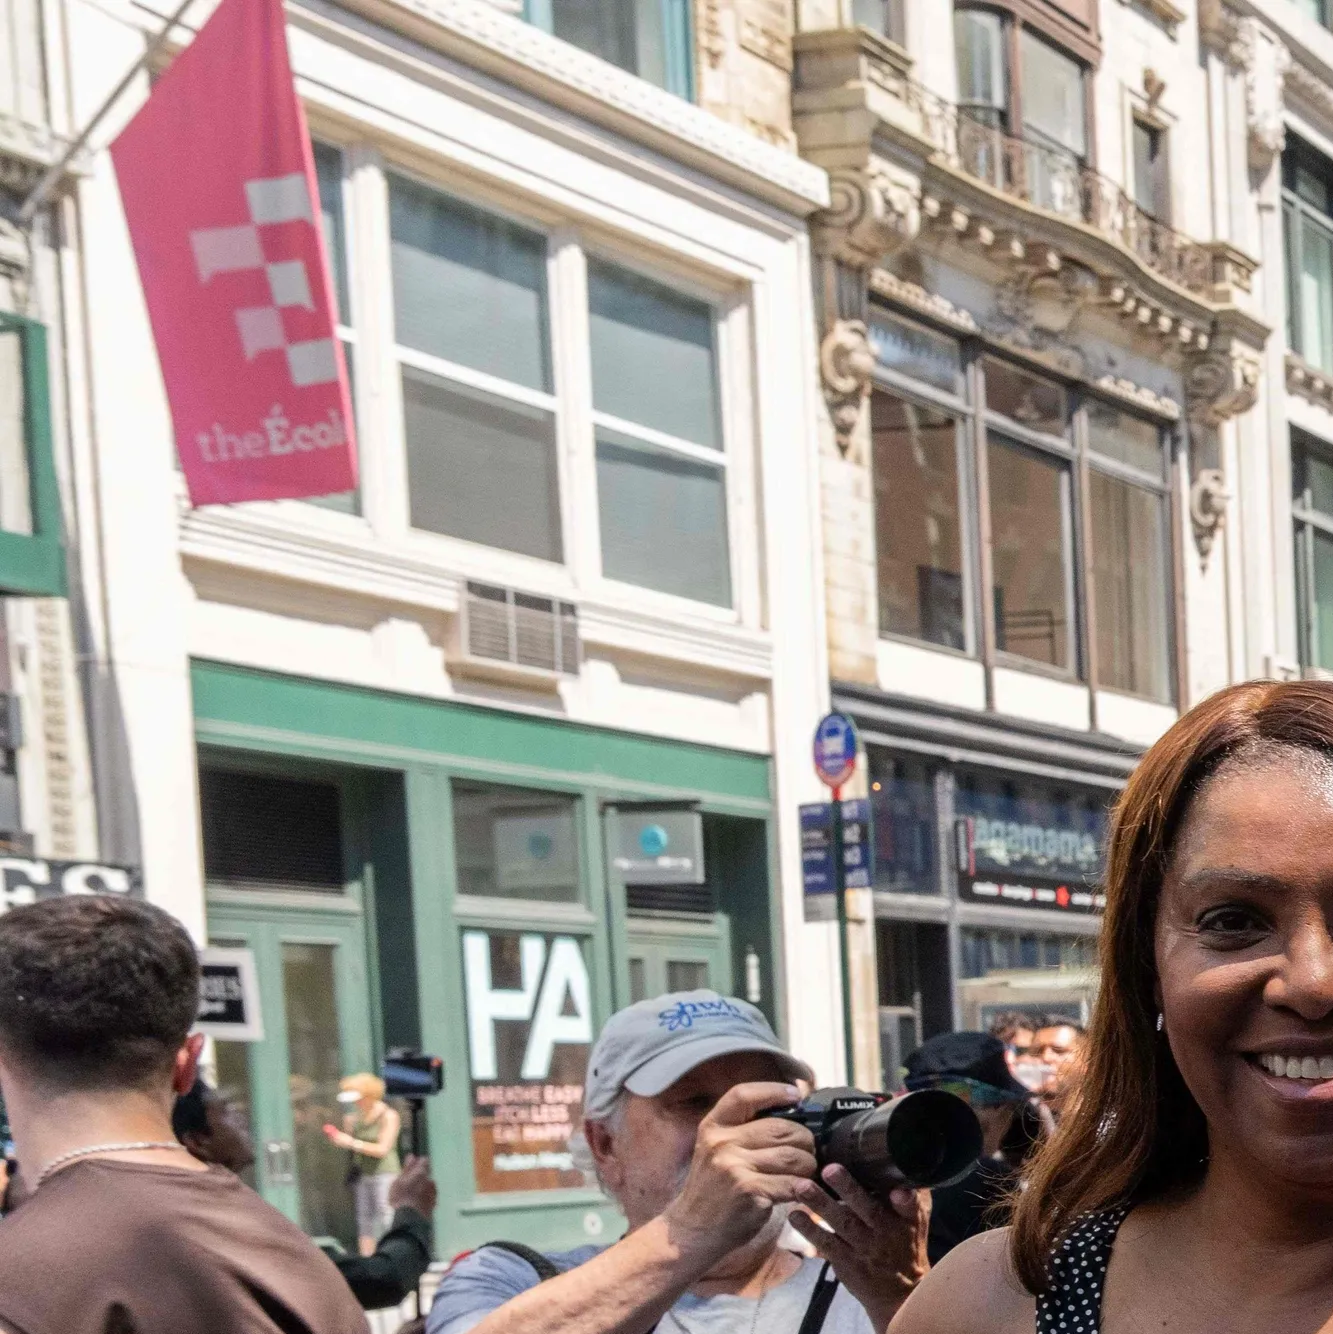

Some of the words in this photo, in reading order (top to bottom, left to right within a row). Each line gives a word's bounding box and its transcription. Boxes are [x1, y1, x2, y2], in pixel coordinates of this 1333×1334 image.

[197, 402, 347, 462] theÉcol
[463, 930, 593, 1080] HA
[836, 1100, 876, 1110] LUMIX
